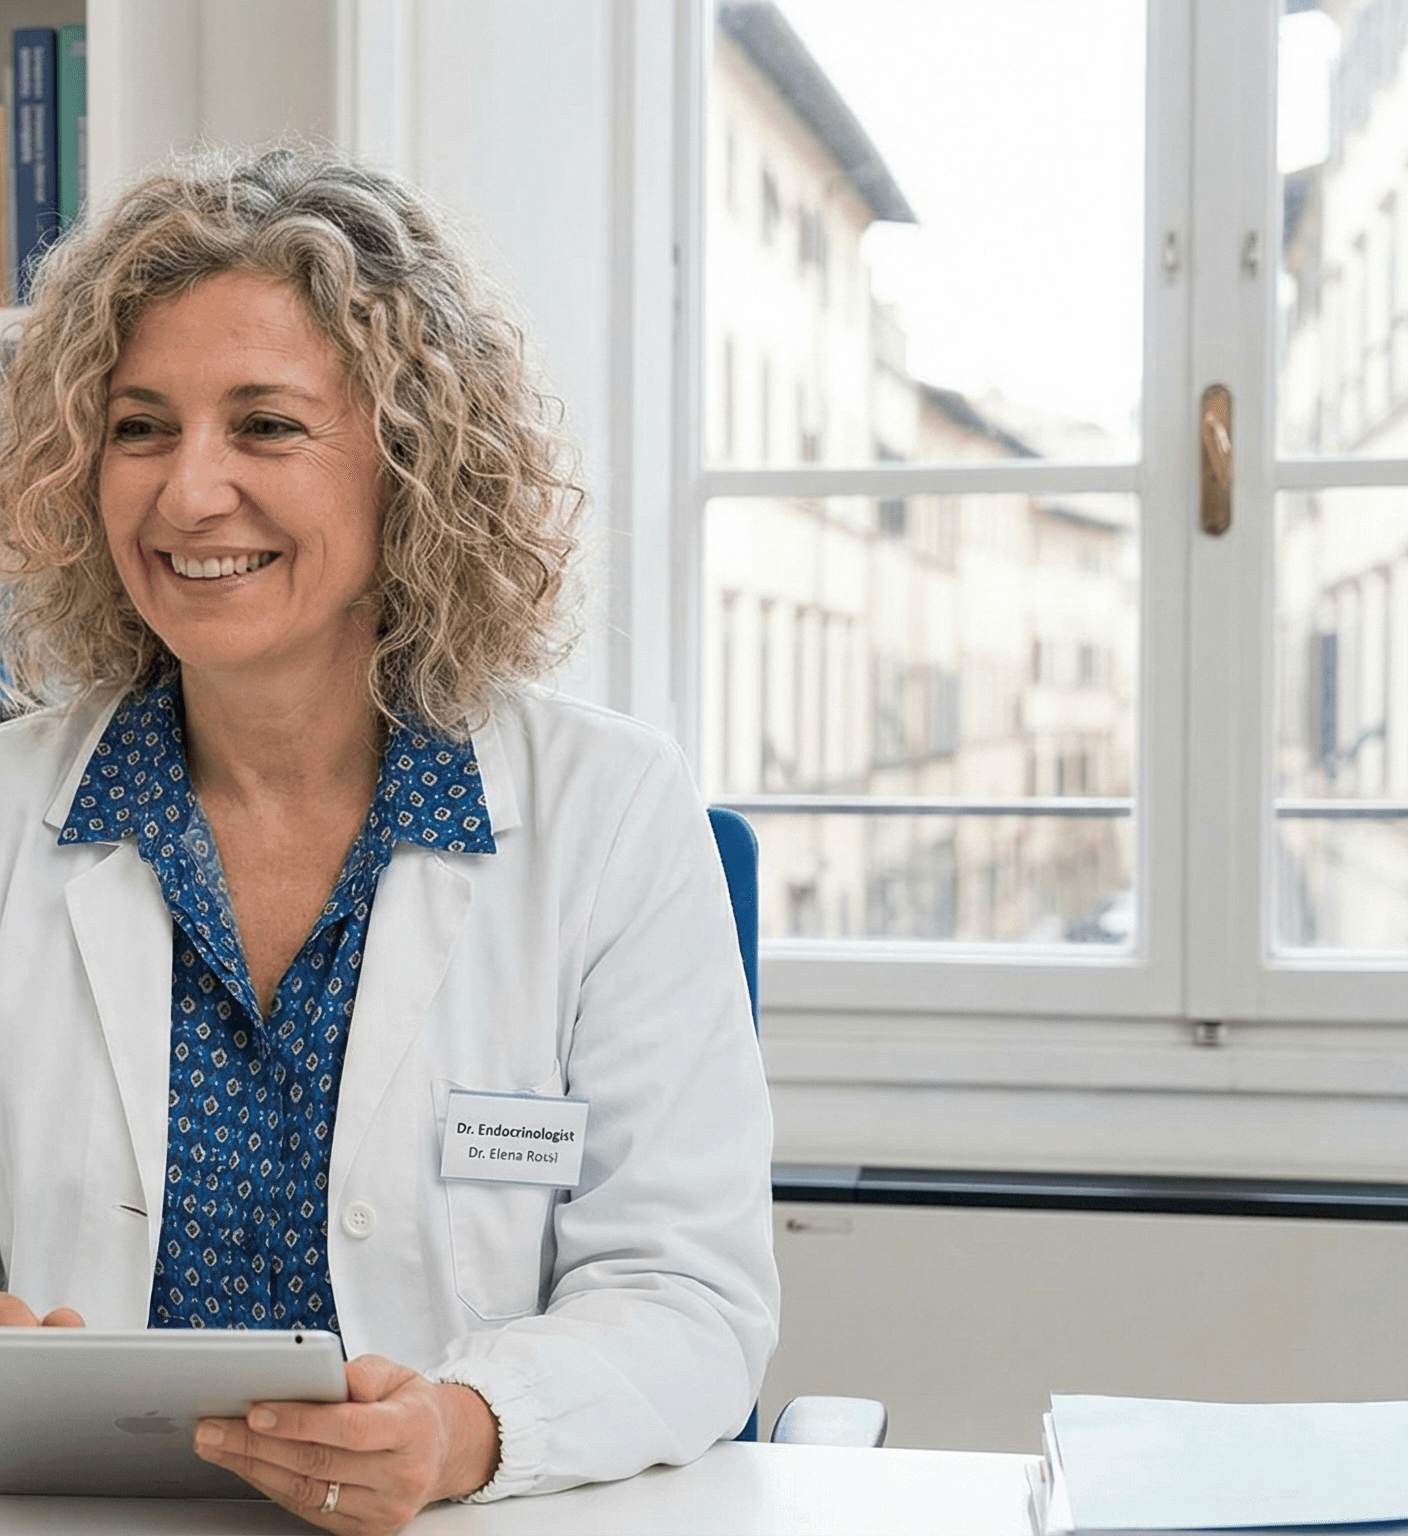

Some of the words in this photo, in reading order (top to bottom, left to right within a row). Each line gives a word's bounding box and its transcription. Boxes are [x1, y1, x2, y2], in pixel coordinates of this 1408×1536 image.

[456, 1122, 474, 1135] Dr.
[477, 1123, 575, 1143] Endocrinologist
[468, 1146, 485, 1159] Dr.
[489, 1147, 523, 1161] Elena
